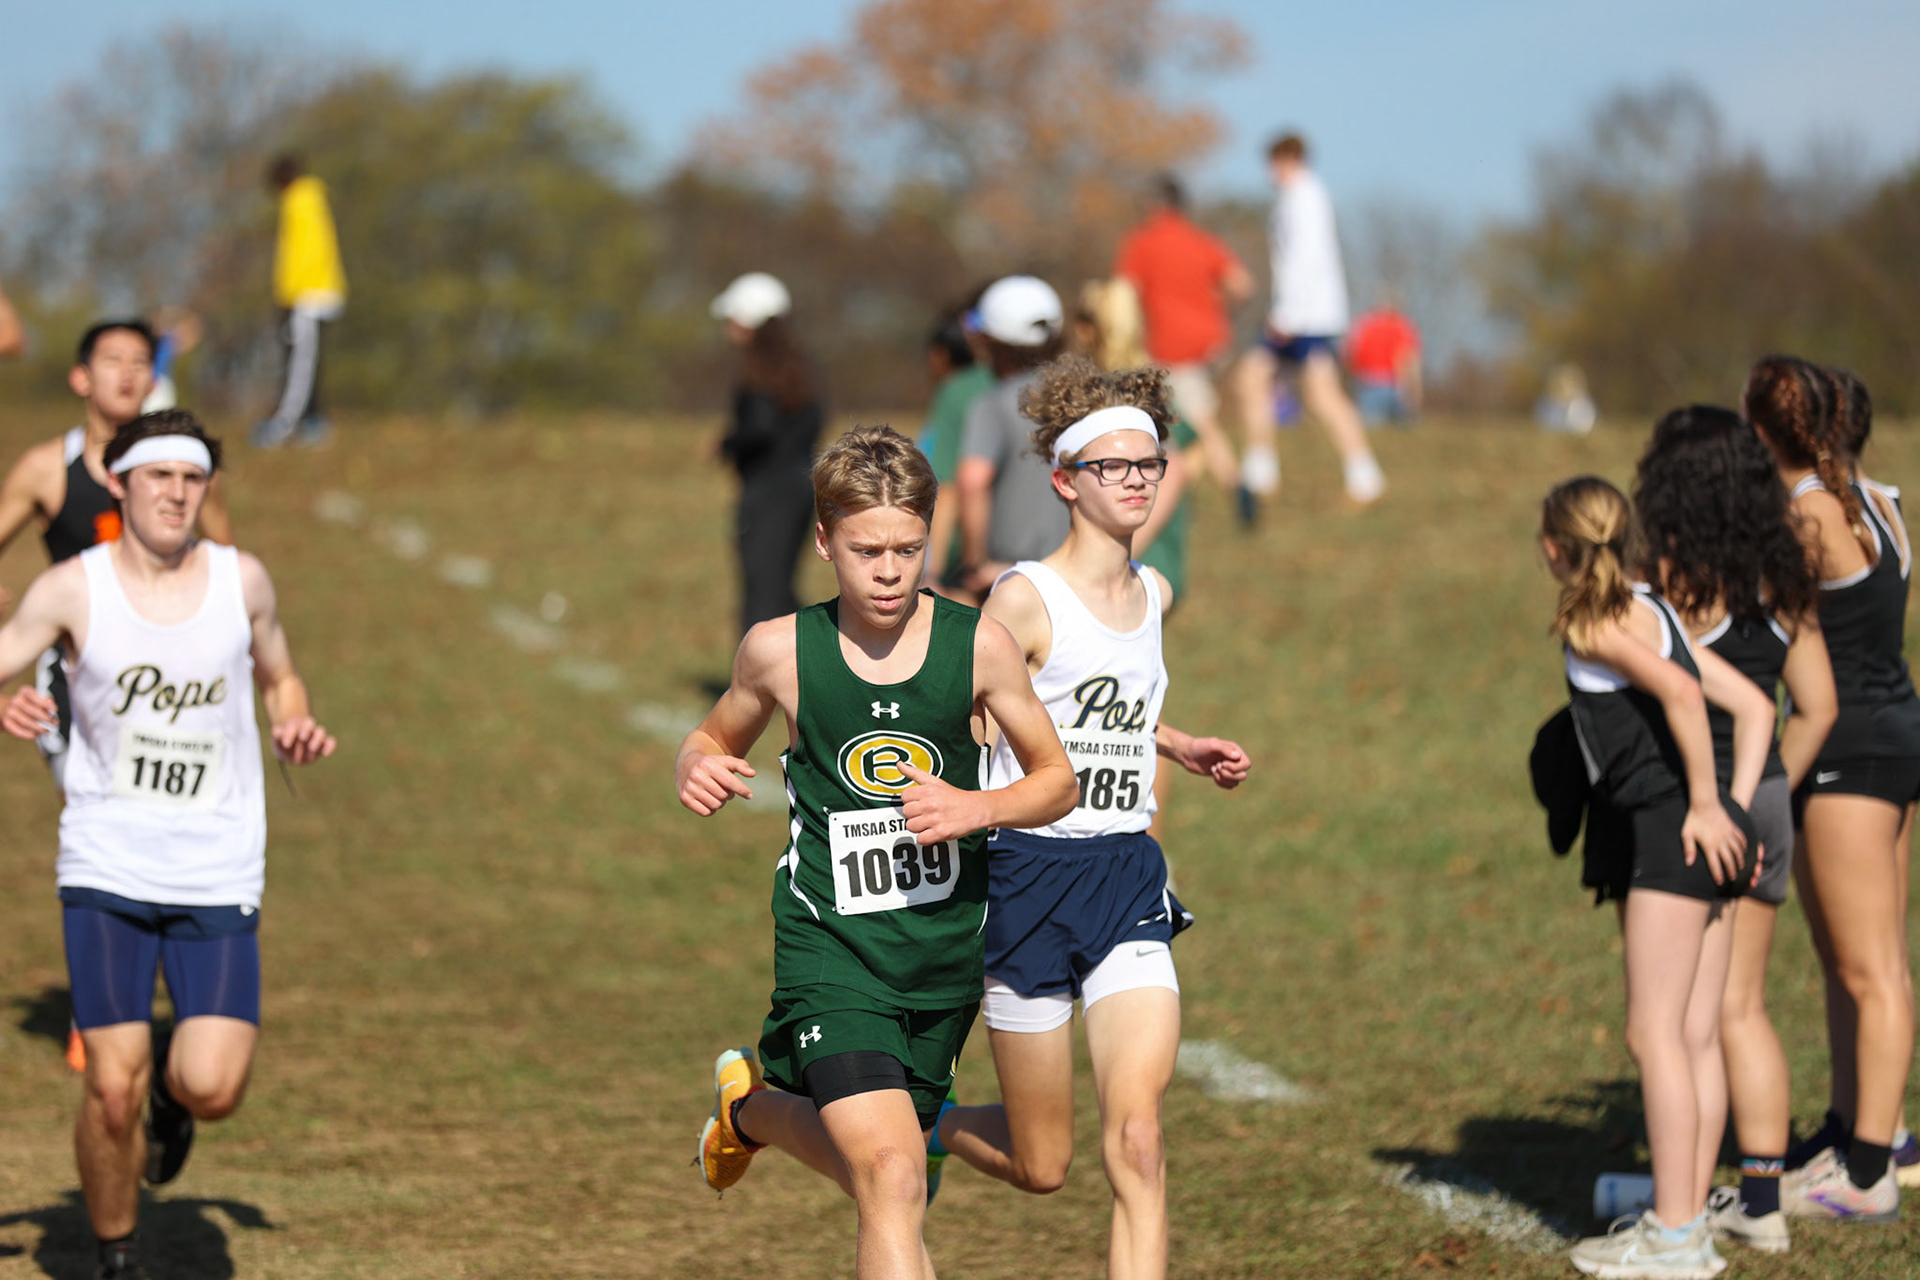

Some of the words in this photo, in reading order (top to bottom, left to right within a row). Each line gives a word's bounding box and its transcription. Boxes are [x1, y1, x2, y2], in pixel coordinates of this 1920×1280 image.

[111, 663, 227, 724] Pope
[1064, 740, 1100, 755] TMSAA
[1102, 743, 1132, 757] STATE
[1132, 744, 1144, 758] XC
[132, 755, 207, 797] 1187
[842, 821, 887, 838] TMSAA
[840, 841, 952, 898] 1039
